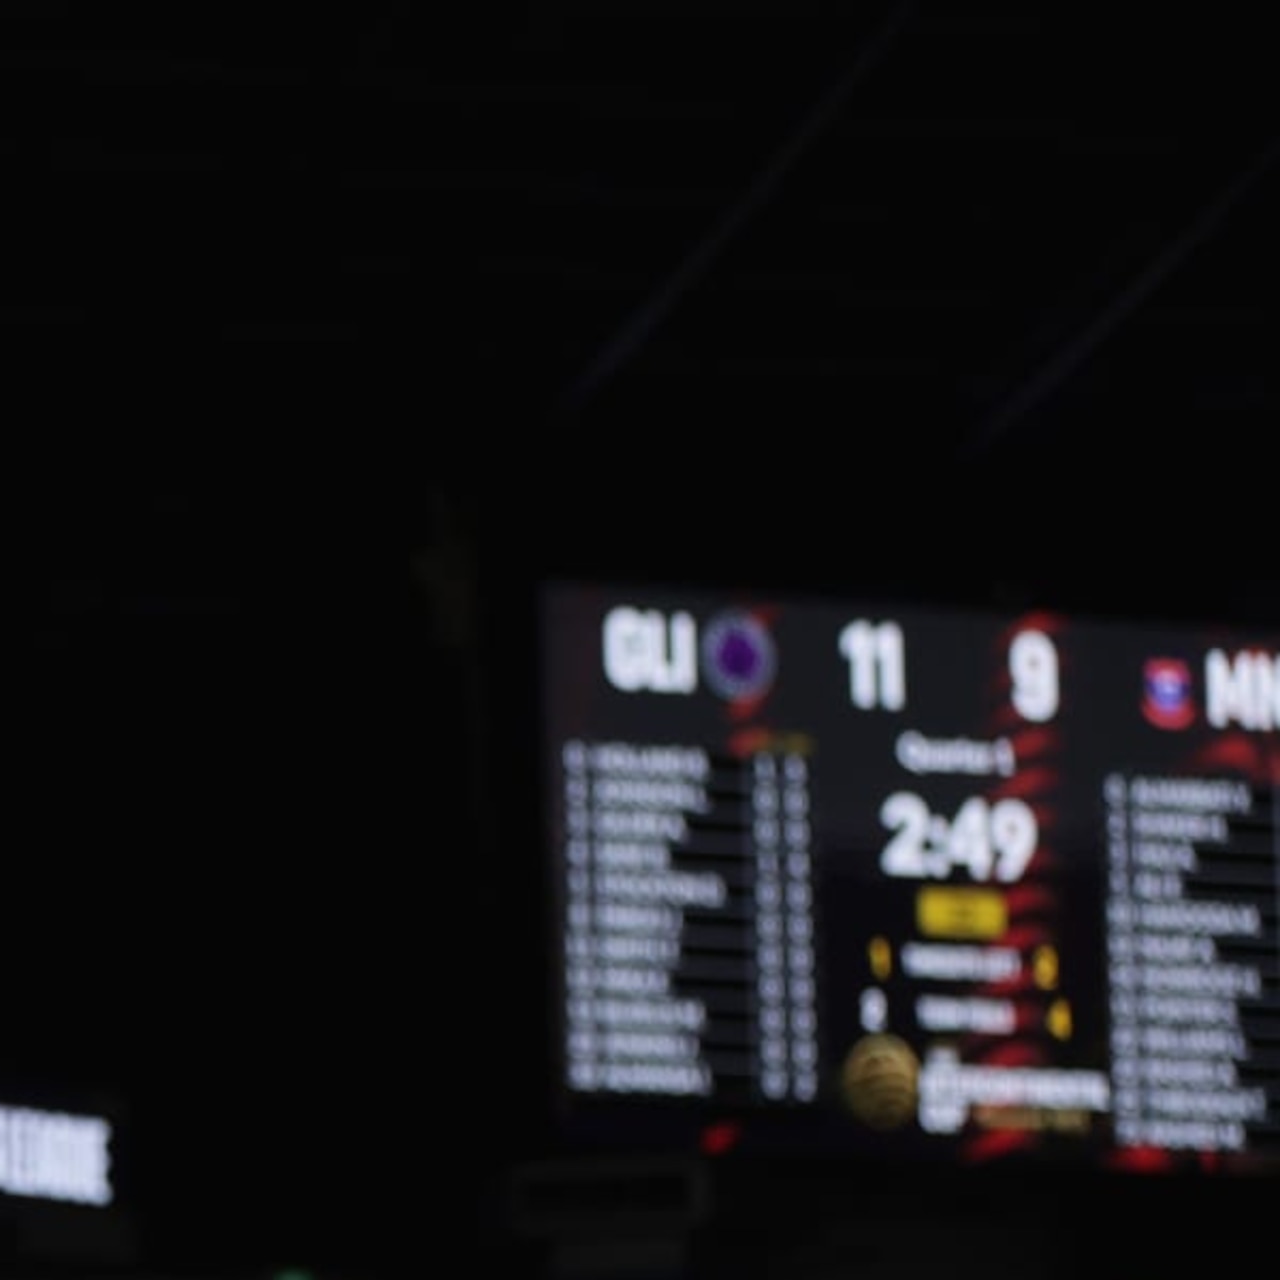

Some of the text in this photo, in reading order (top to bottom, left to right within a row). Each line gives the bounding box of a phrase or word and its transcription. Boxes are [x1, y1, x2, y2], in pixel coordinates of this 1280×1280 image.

[839, 617, 907, 712] 11
[1010, 628, 1060, 722] 9
[879, 793, 1038, 882] 2:49
